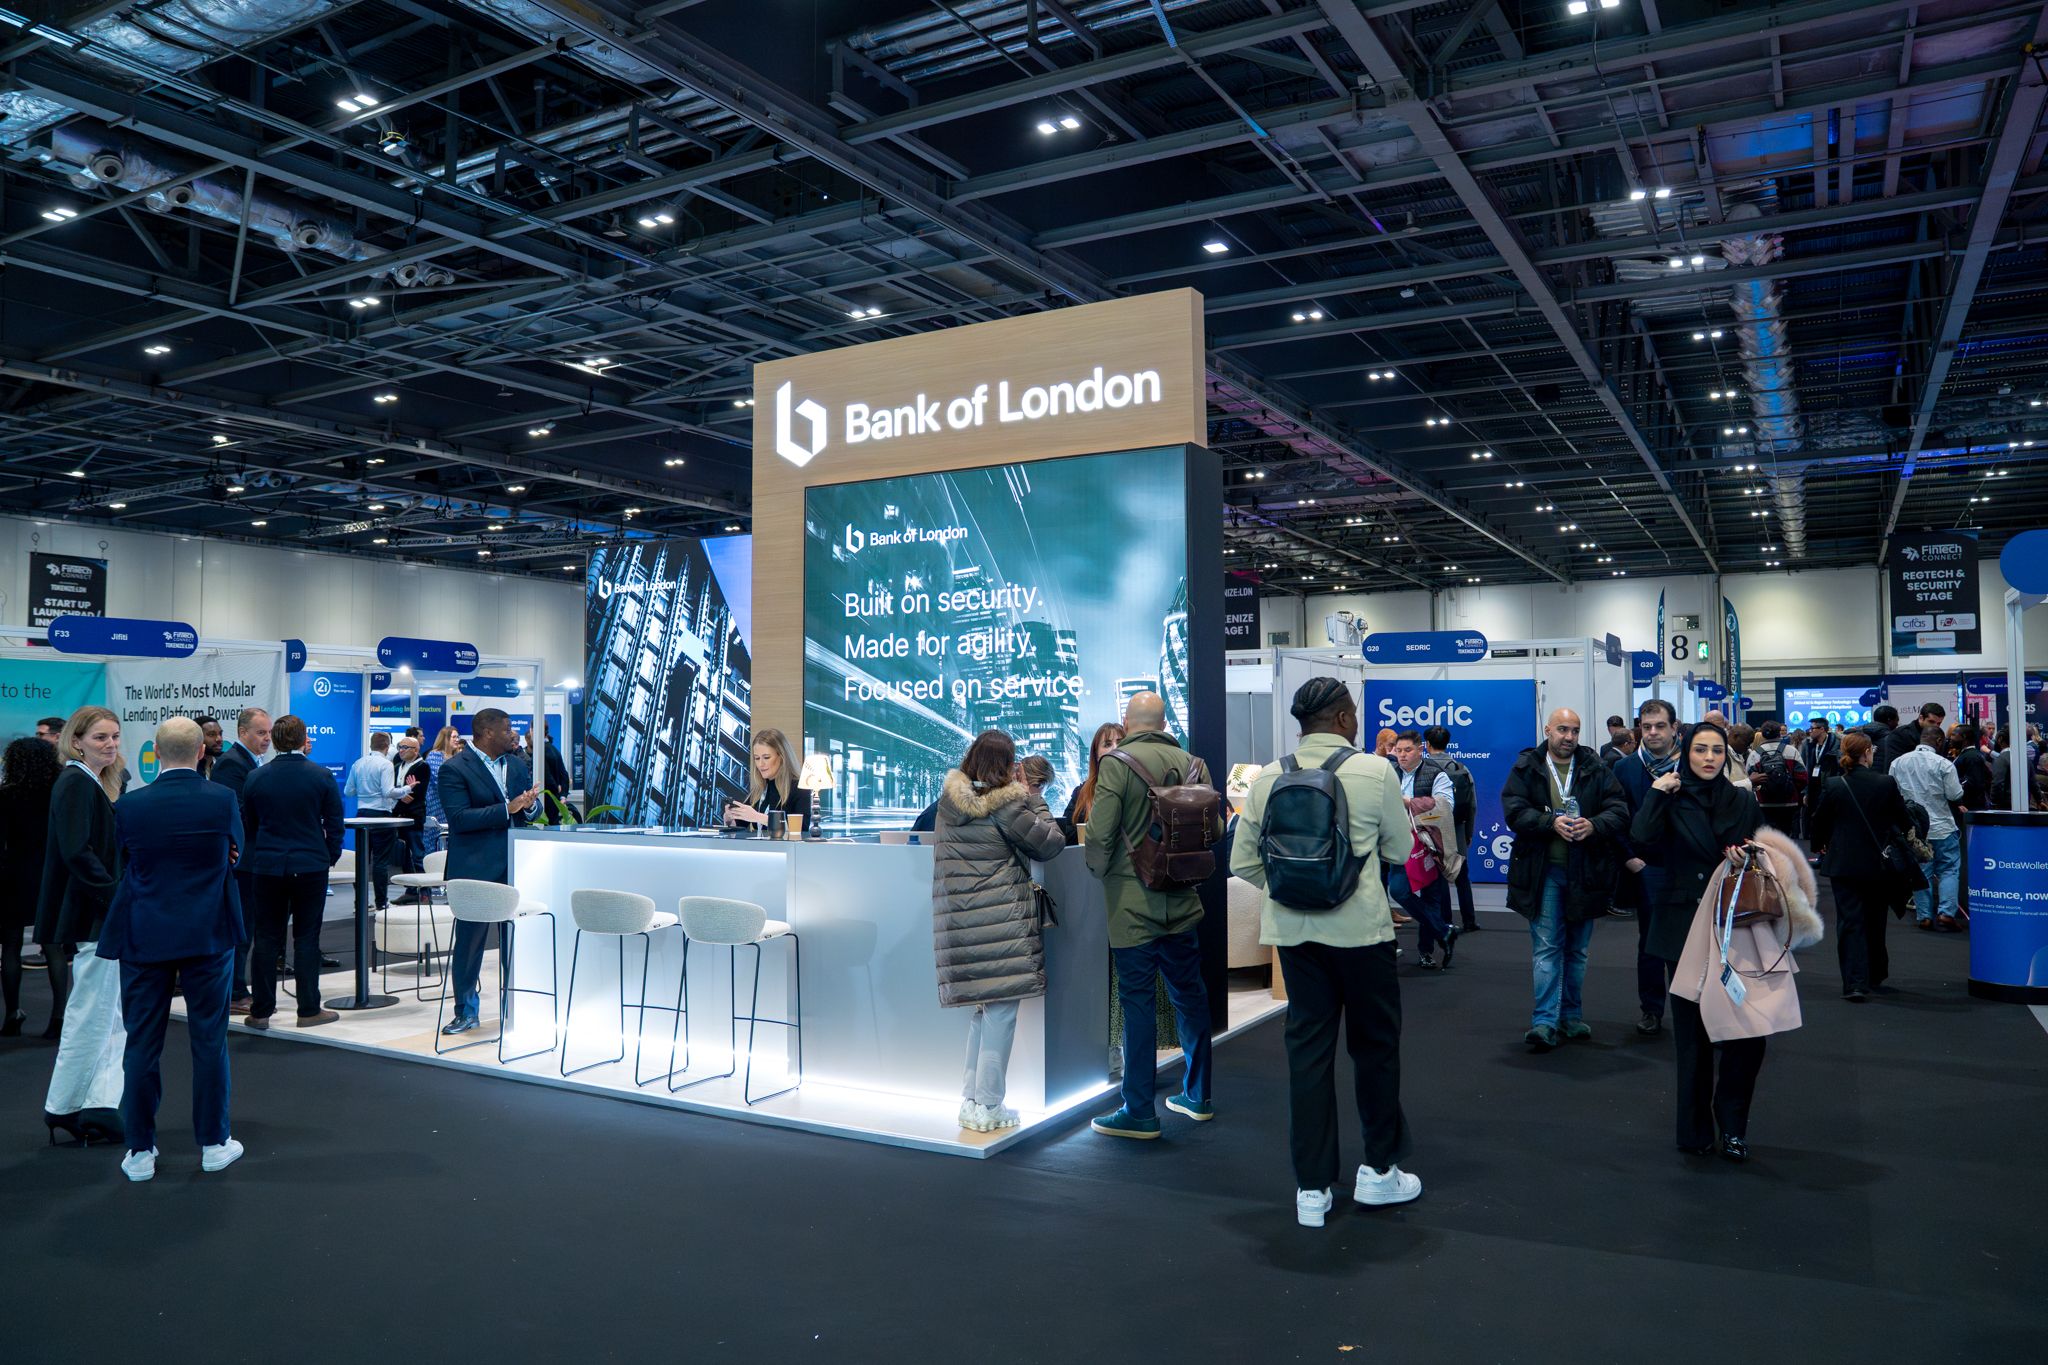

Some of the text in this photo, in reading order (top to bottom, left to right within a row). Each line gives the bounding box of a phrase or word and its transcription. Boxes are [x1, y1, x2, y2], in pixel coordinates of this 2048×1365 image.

[846, 367, 1161, 443] Bank of London
[870, 525, 968, 546] Bank of London
[1922, 544, 1962, 554] FinTech
[1922, 553, 1962, 561] CONNECT
[1903, 569, 1965, 580] REGTECH &
[614, 581, 633, 594] Bank
[646, 579, 677, 591] London
[1907, 581, 1962, 591] SECURITY
[845, 582, 1044, 617] Built on security.
[1916, 592, 1953, 601] STAGE
[44, 598, 91, 609] START UP
[1225, 614, 1254, 623] ENIZE
[1903, 618, 1926, 629] cifas
[55, 630, 70, 638] F33
[1225, 626, 1243, 635] AGE
[845, 627, 1037, 660] Made for agility.
[1671, 635, 1689, 660] 8
[1, 683, 52, 699] to the
[125, 680, 256, 700] The World's Most Modular
[845, 670, 1091, 701] Focused on service.
[381, 705, 403, 713] Lending
[2006, 701, 2036, 712] cas
[123, 706, 157, 725] Lending
[160, 705, 204, 721] Platform
[1379, 698, 1473, 727] Sedric
[320, 726, 336, 734] on.
[1968, 887, 1980, 897] pen
[1981, 888, 2023, 902] finance,
